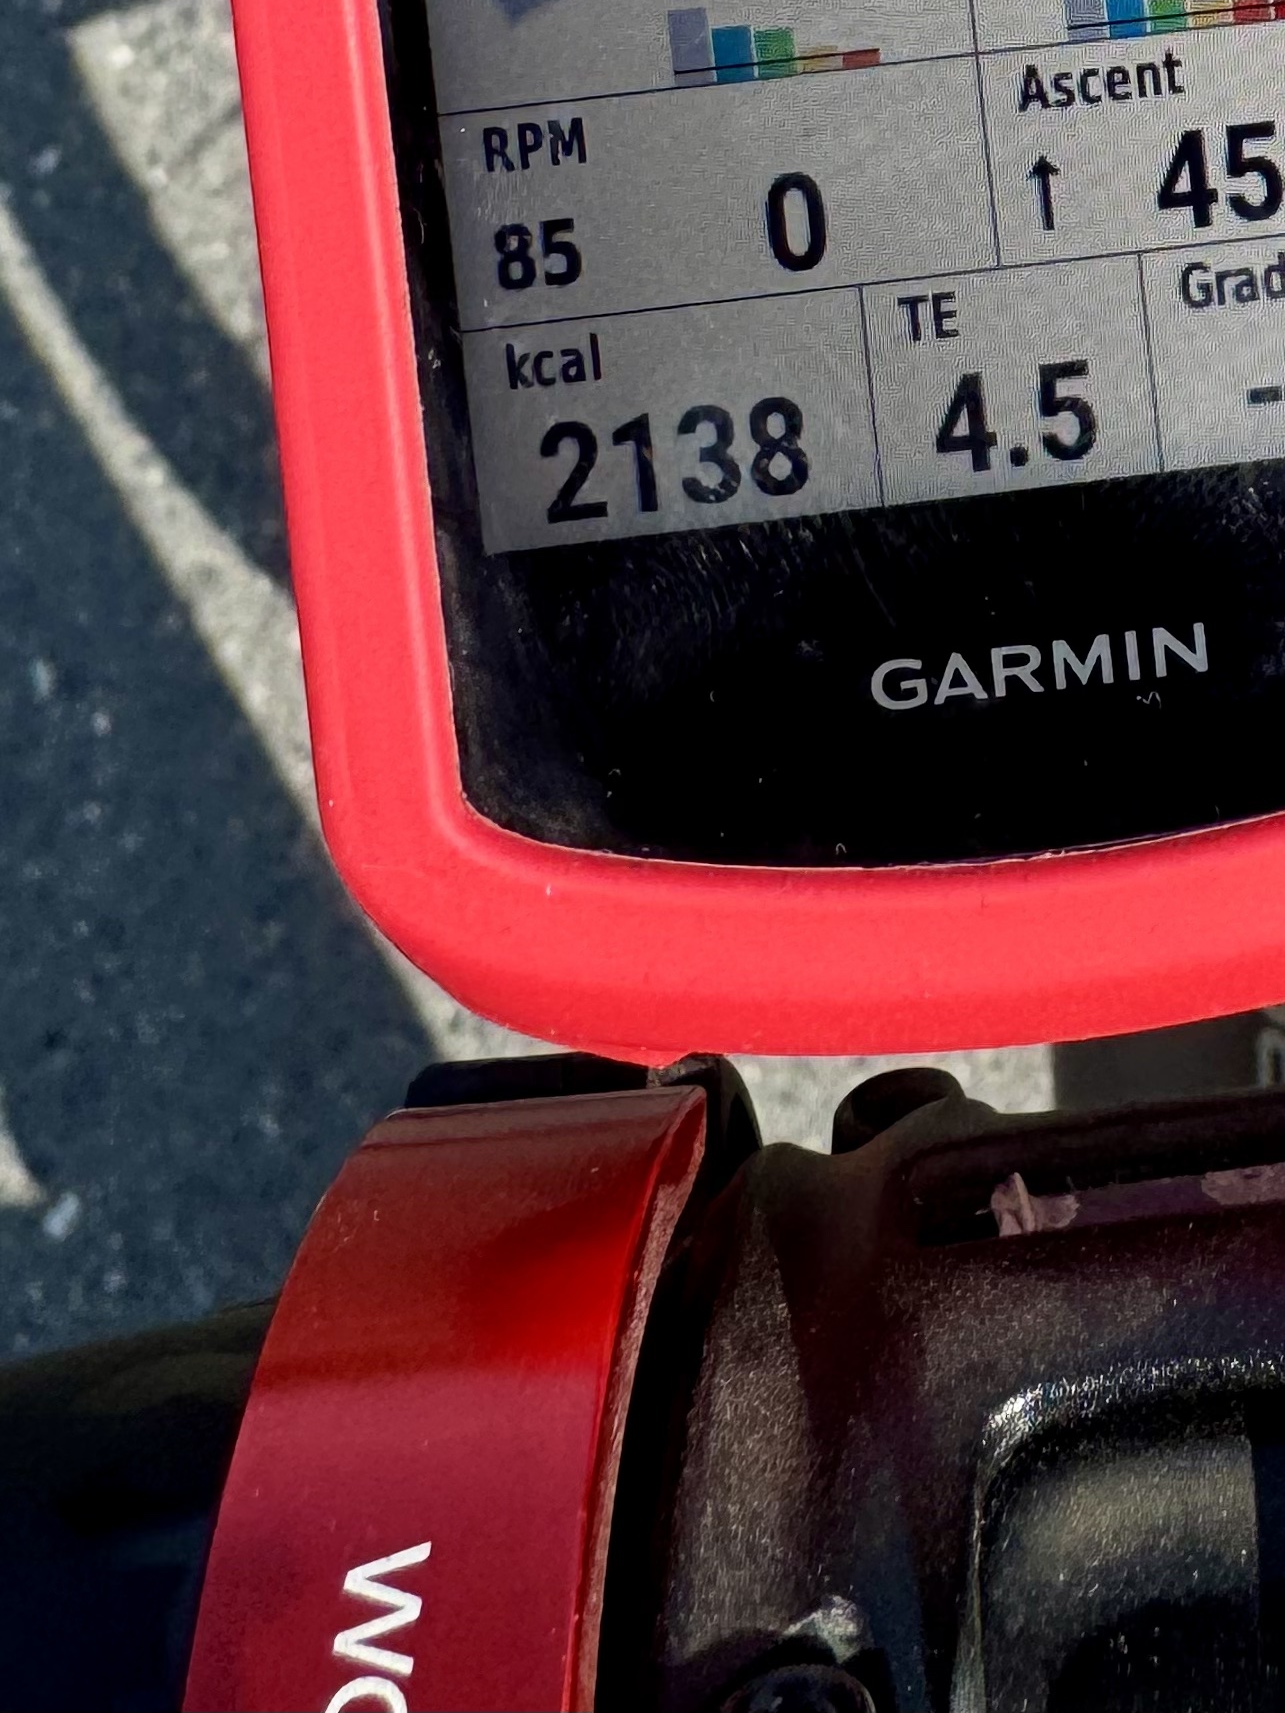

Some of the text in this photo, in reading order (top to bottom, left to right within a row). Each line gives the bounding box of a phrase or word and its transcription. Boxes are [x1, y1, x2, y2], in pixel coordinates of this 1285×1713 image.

[1016, 50, 1185, 112] Ascent
[483, 118, 586, 173] RPM
[494, 172, 826, 291] 85 0
[898, 290, 960, 342] TE
[506, 333, 601, 389] kcal
[936, 359, 1096, 472] 4.5
[539, 397, 808, 525] 2138
[871, 623, 1208, 709] GARMIN
